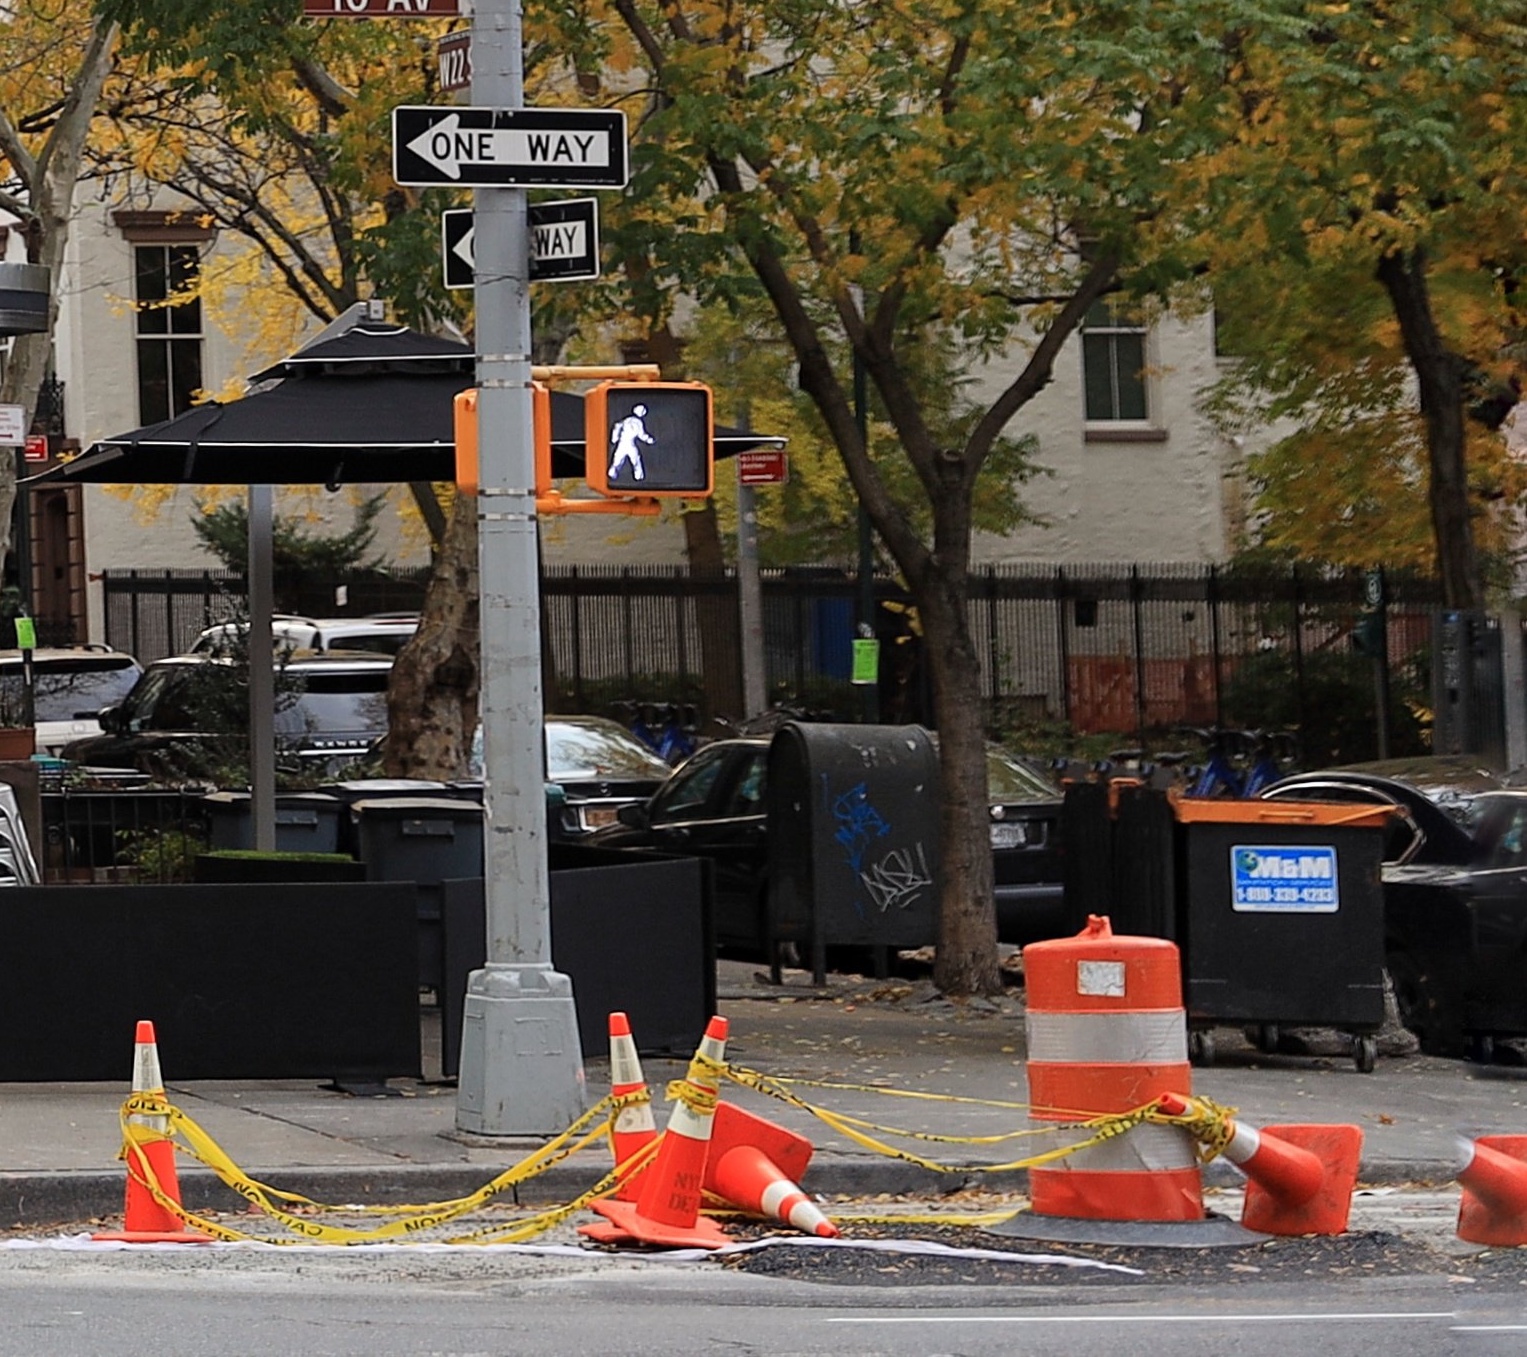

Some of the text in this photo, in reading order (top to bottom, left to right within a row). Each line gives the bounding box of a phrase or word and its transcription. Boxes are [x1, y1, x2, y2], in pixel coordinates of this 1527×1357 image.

[431, 132, 594, 162] ONE WAY
[534, 225, 577, 257] WAY
